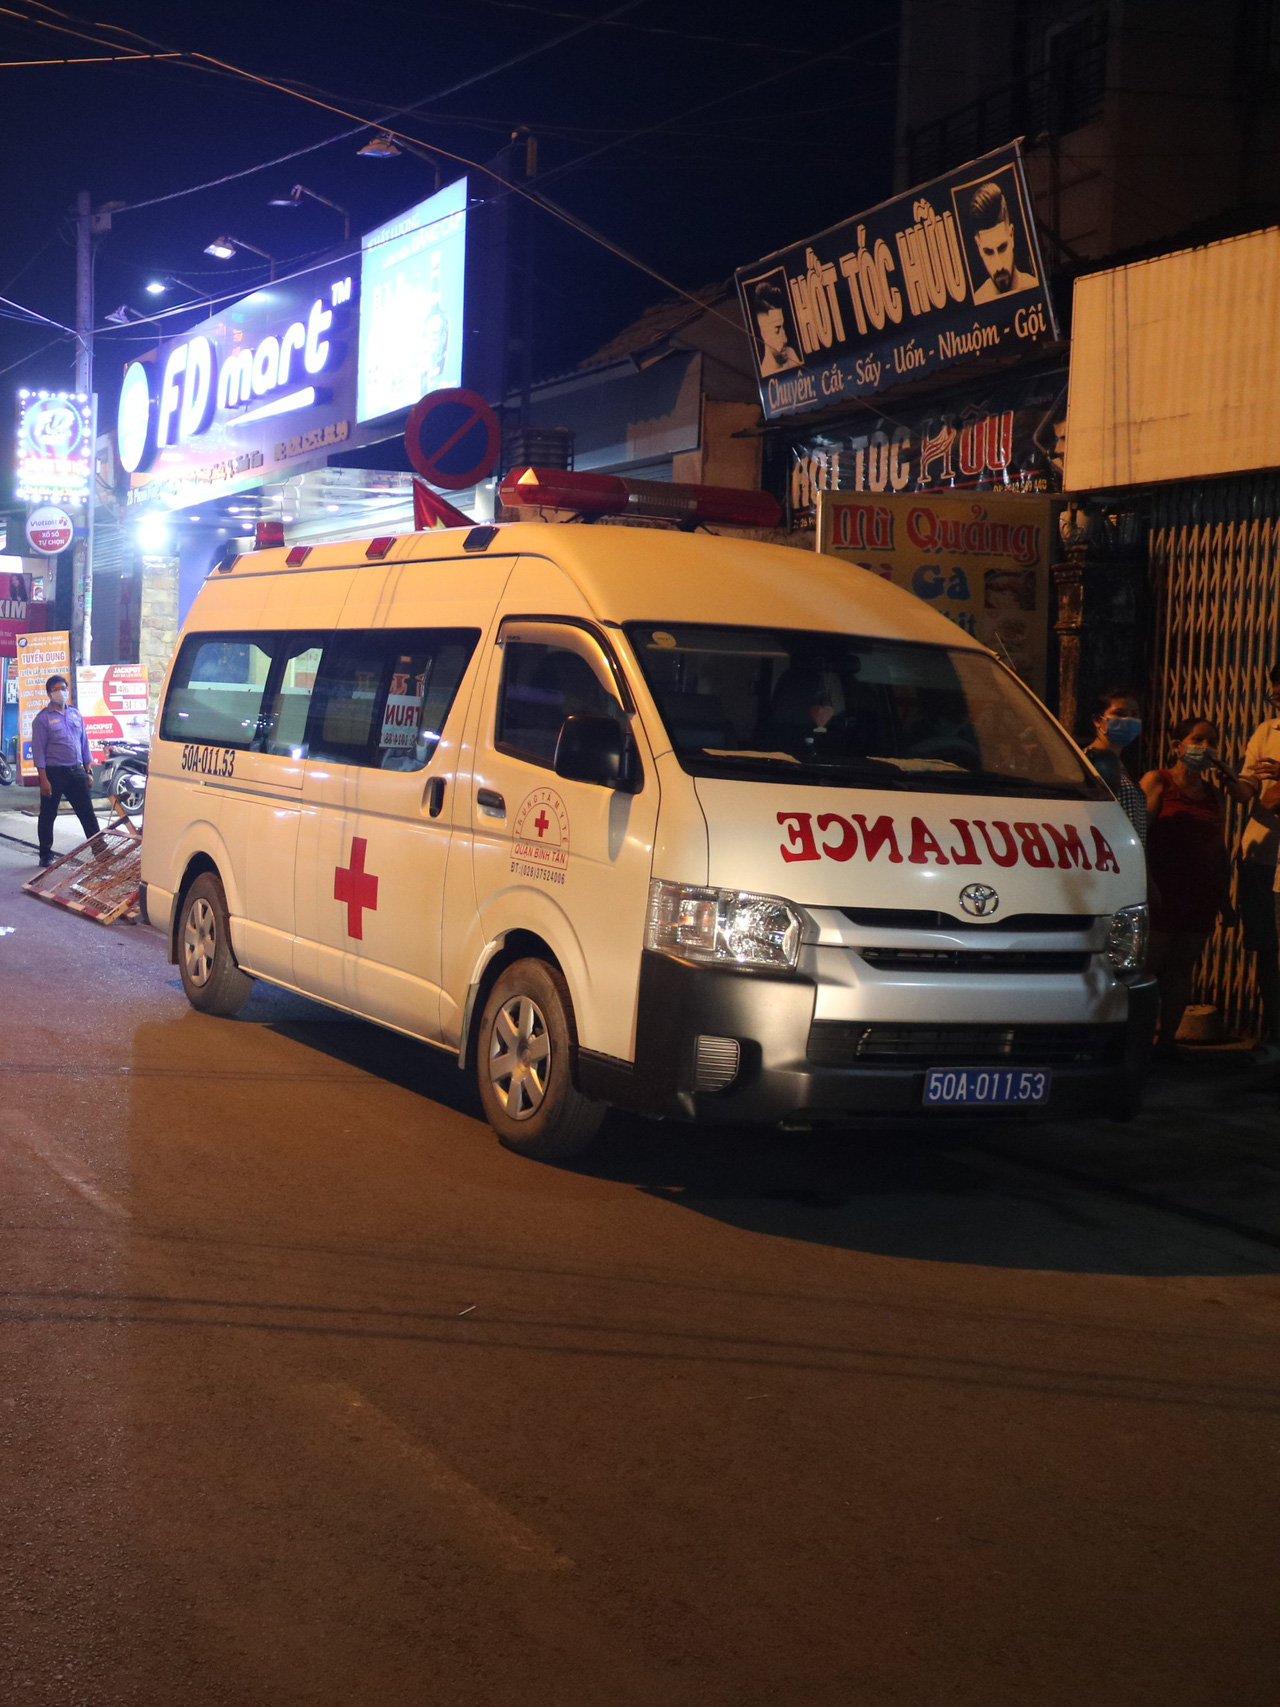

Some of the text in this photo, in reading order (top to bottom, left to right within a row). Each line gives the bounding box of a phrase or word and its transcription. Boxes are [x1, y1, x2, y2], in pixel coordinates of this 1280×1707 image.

[839, 224, 903, 335] TÓC
[895, 198, 966, 316] HỮU
[822, 364, 843, 395] Cắt
[855, 352, 881, 386] Sấy
[894, 339, 926, 373] Uốn
[938, 322, 1000, 360] Nhuộm
[1014, 303, 1046, 340] Gội
[157, 334, 216, 448] FD
[218, 298, 332, 407] mart
[832, 503, 1037, 563] Mì Quảng
[911, 564, 971, 600] Gà
[22, 649, 65, 665] TUYỂN DỤNG
[515, 794, 538, 835] TRUNG
[541, 791, 560, 809] TÂM
[515, 842, 565, 864] QUẬN BÌNH TÂN
[928, 1073, 1046, 1101] 50A-011.53
